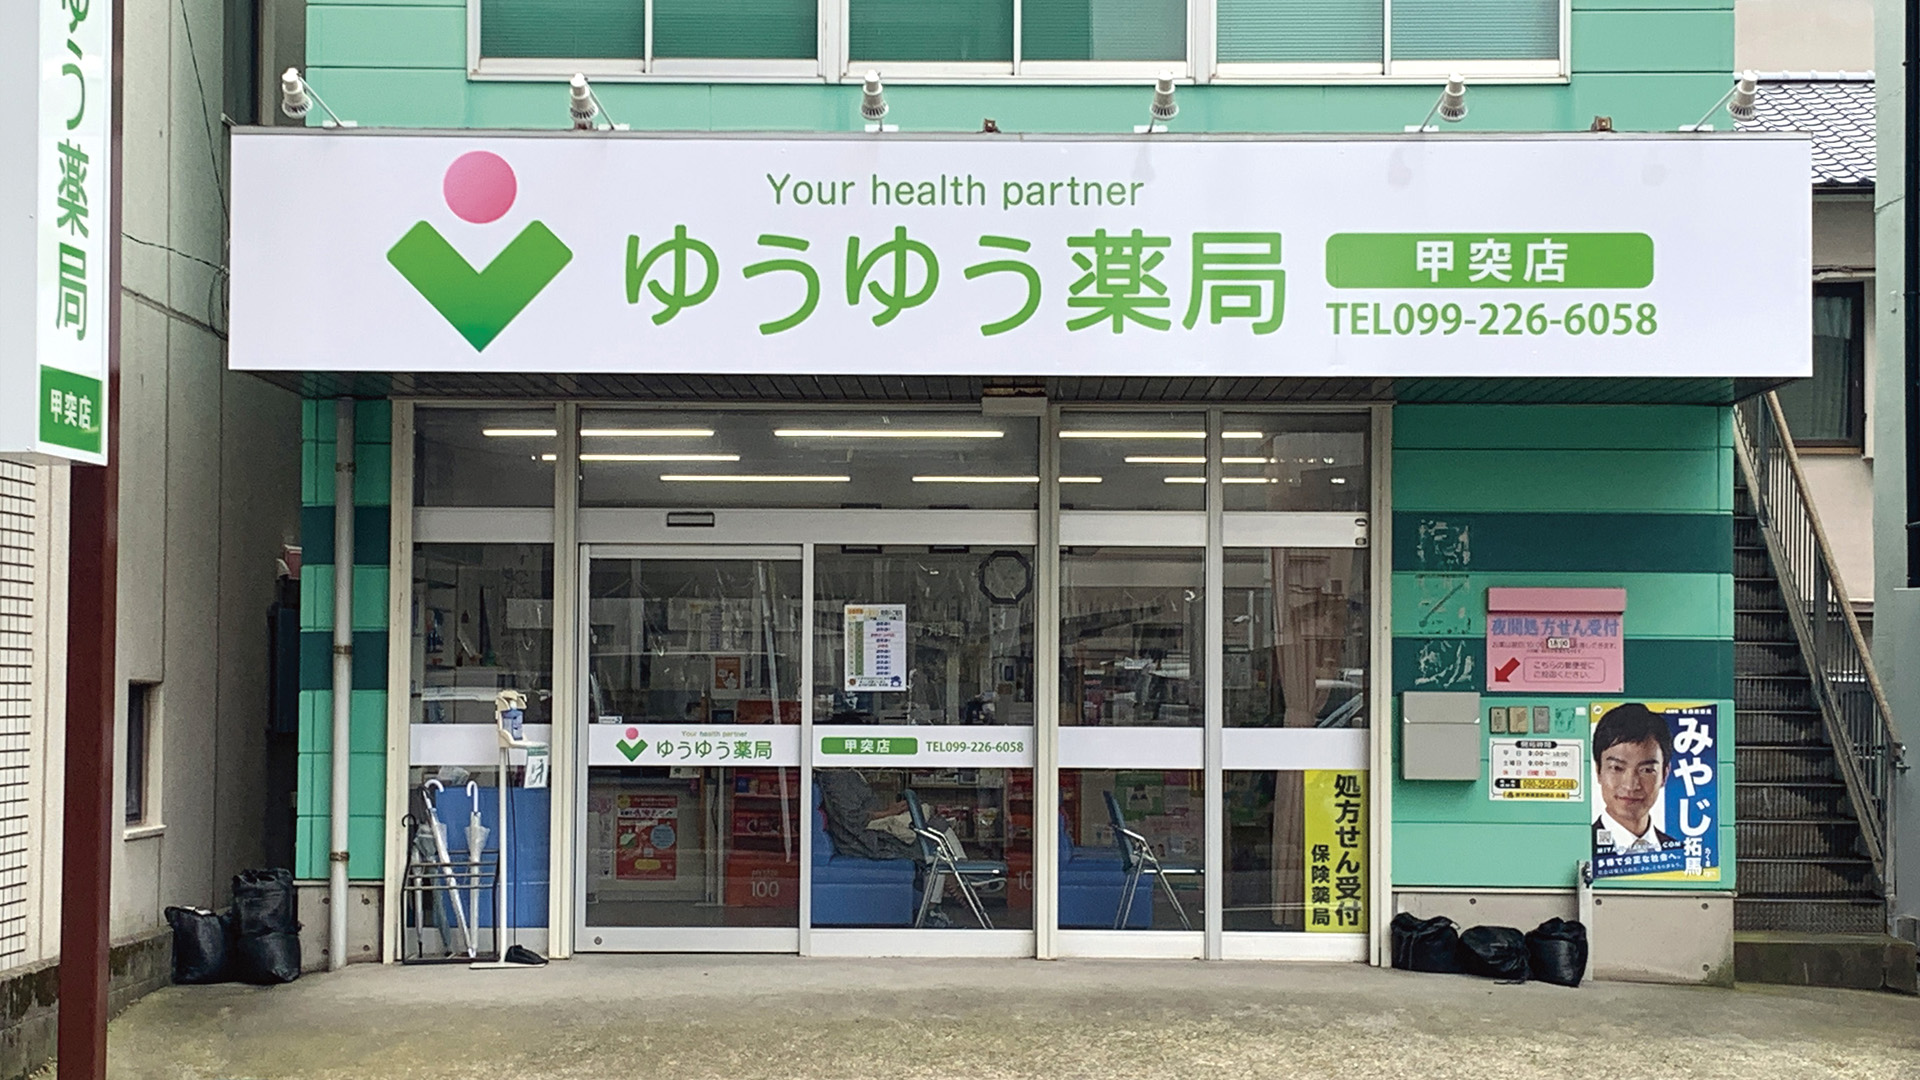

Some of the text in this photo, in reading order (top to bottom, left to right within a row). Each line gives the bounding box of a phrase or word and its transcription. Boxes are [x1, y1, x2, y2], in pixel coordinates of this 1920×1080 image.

[769, 175, 1144, 210] Your health partner
[1415, 239, 1569, 283] 甲突店
[625, 224, 1287, 336] ゆうゆう薬局
[1326, 302, 1658, 336] TEL099-226-6058
[51, 388, 92, 430] 甲突店
[656, 740, 773, 760] ゆうゆう薬局
[722, 730, 748, 739] partner
[844, 739, 891, 754] 甲突店
[926, 741, 1024, 753] TEL099-226-6058
[1334, 774, 1361, 926] 処方せん受付
[752, 881, 779, 897] 100
[1311, 844, 1330, 926] 保険薬局
